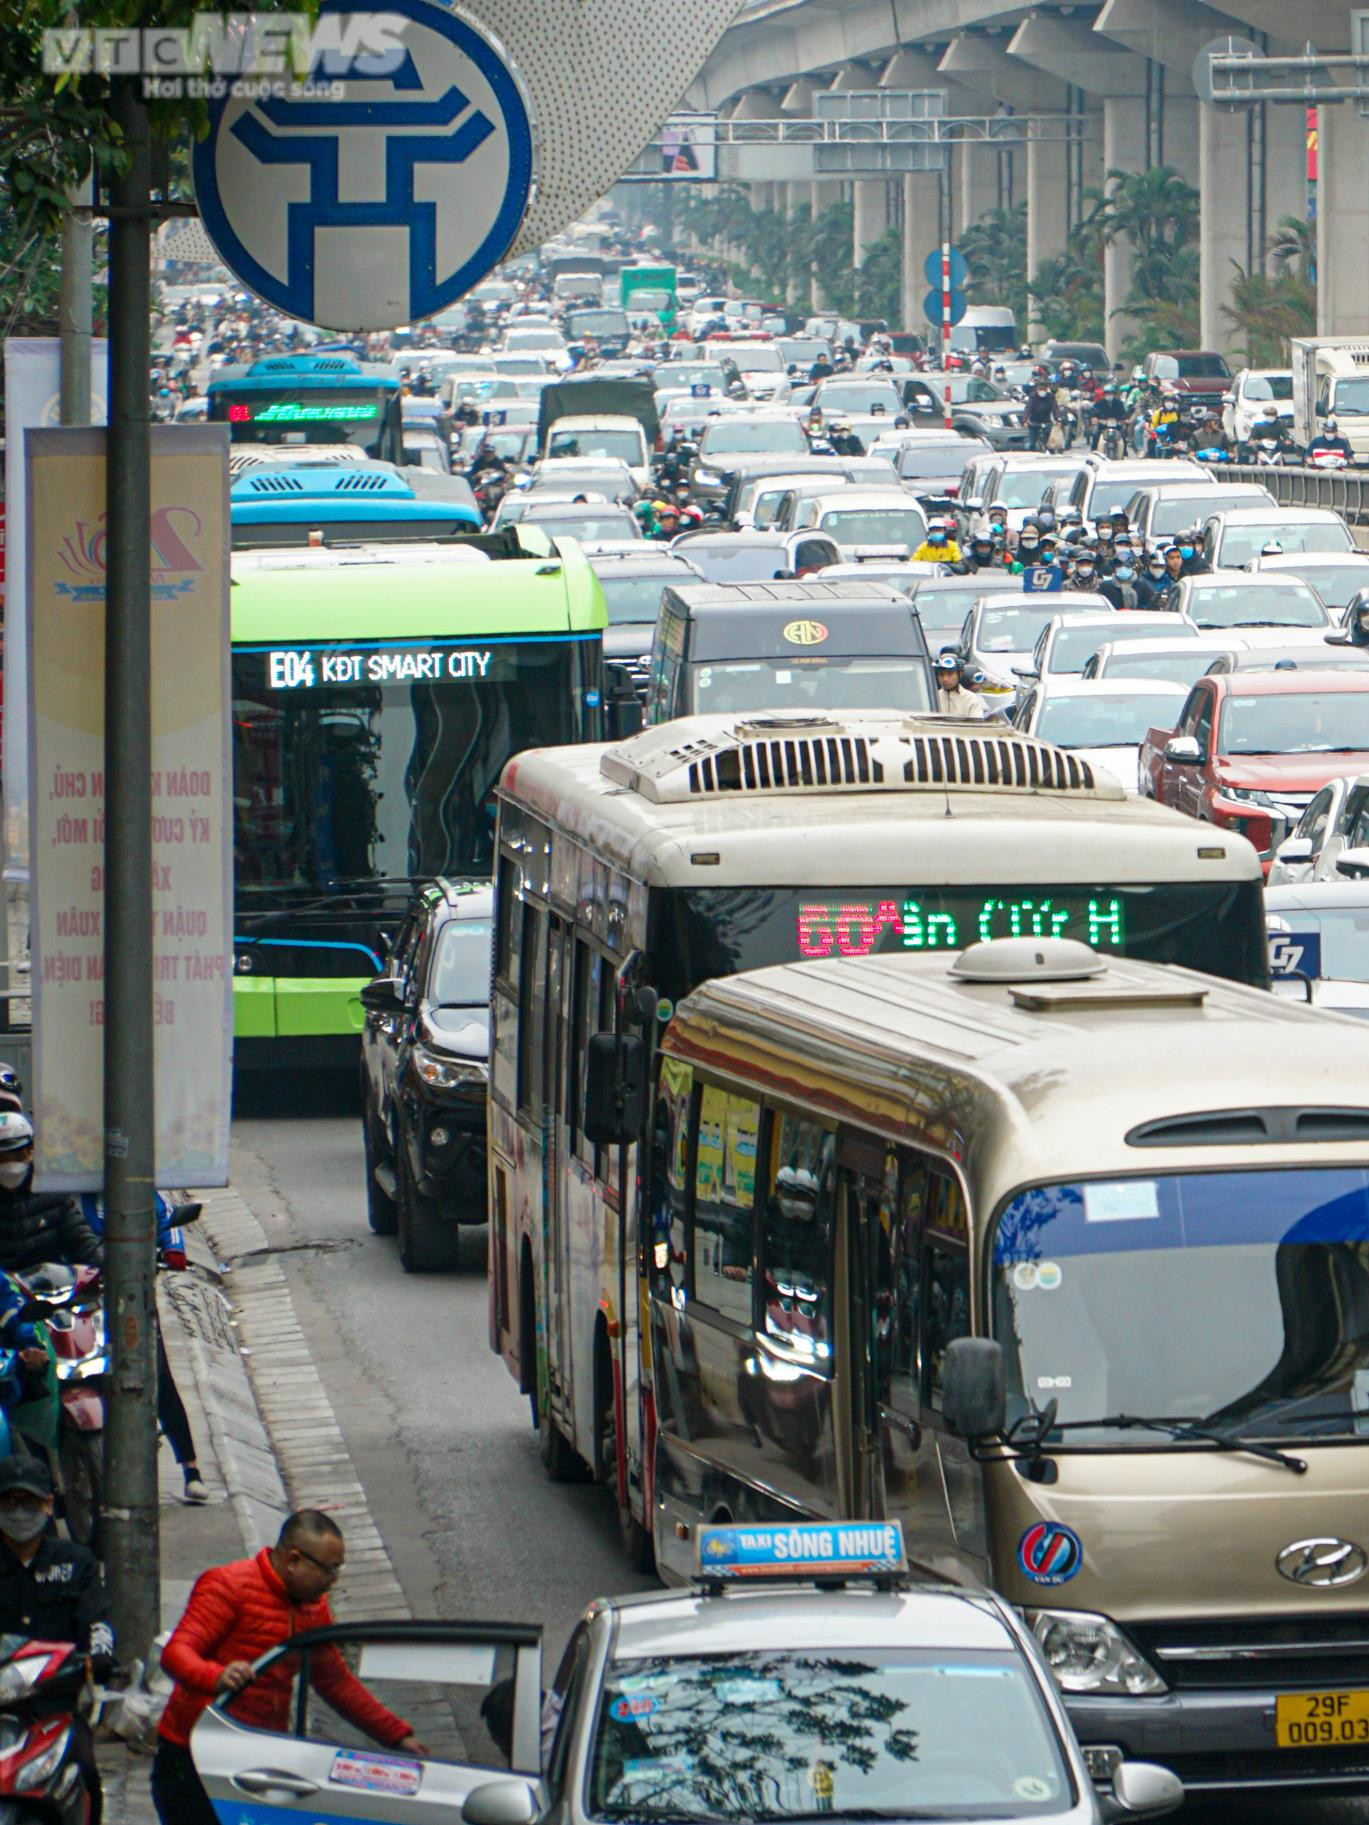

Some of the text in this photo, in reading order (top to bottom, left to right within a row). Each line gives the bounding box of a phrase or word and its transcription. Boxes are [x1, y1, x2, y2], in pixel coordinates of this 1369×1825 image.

[270, 652, 314, 688] E04
[368, 654, 444, 681] SMART
[448, 652, 492, 678] CITY
[739, 1525, 896, 1561] TAXI SÔNG NHUỆ
[1306, 1695, 1351, 1718] 29F
[1288, 1719, 1369, 1743] 009.03
